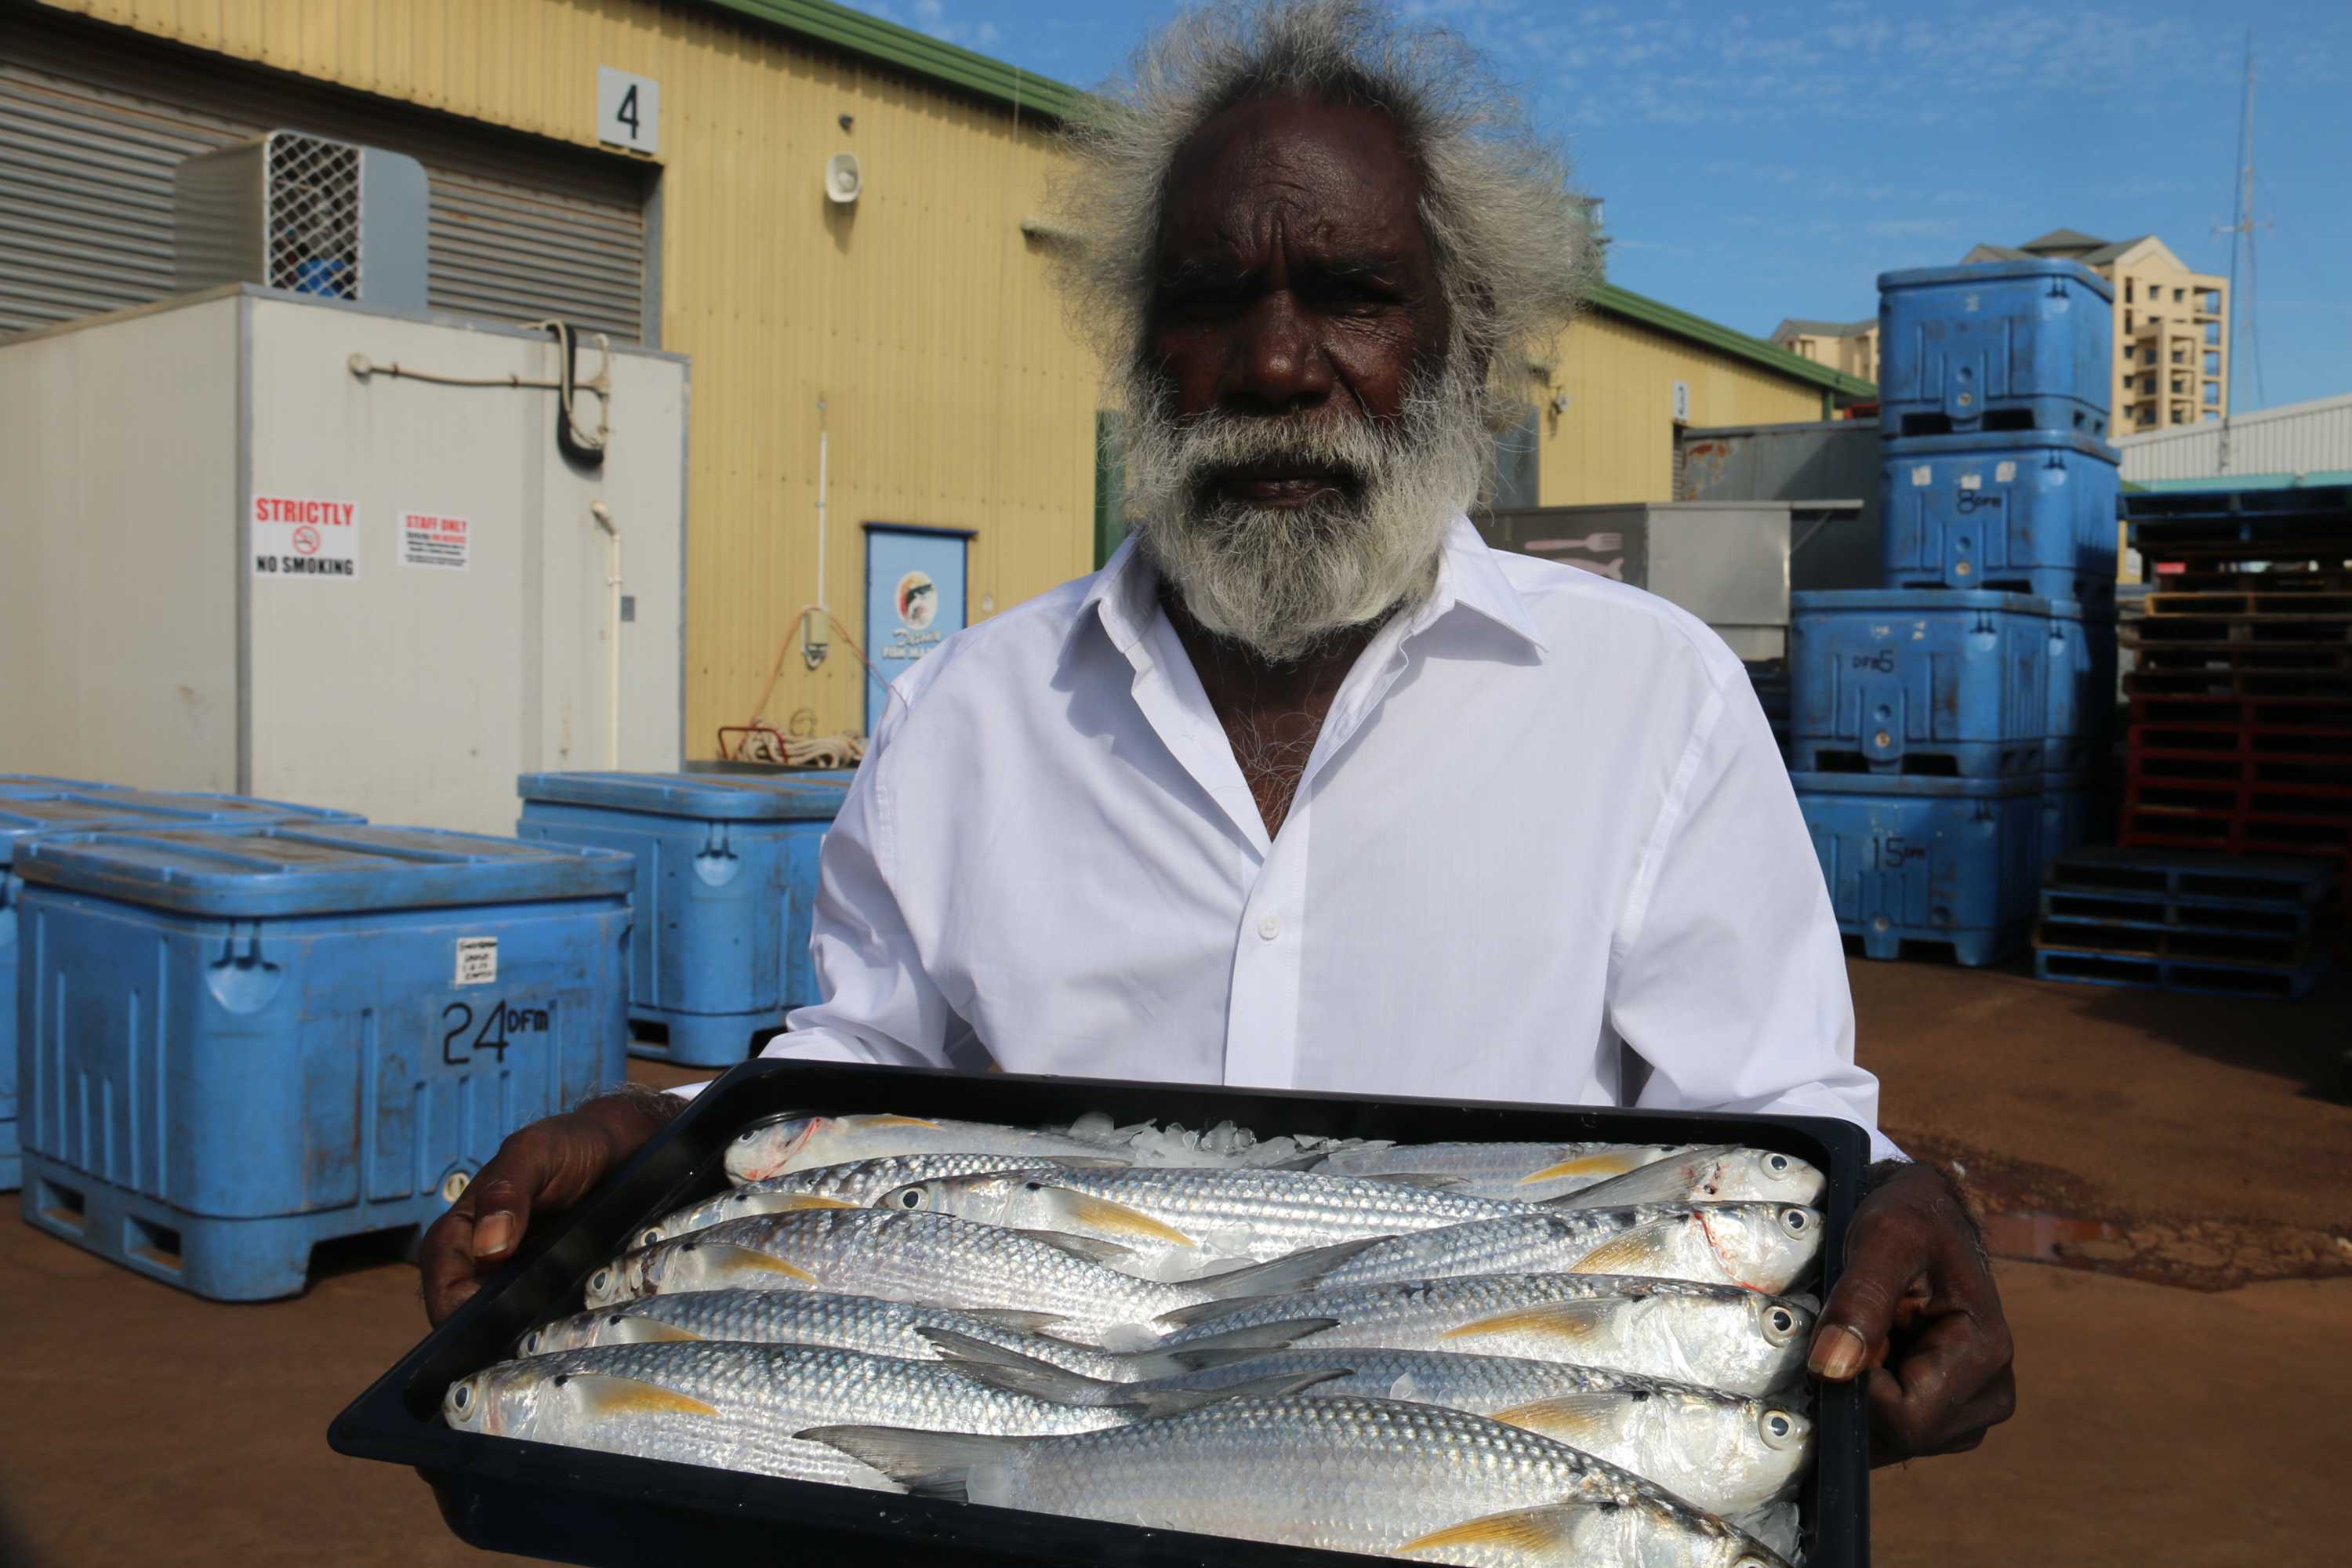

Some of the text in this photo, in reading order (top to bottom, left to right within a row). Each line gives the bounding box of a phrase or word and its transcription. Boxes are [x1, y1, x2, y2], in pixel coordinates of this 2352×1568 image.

[617, 83, 639, 140] 4
[256, 498, 354, 525] STRICTLY
[406, 514, 437, 530] STAFF
[256, 556, 354, 575] NO SMOKING
[1873, 837, 1906, 869] 15
[442, 1000, 509, 1065] 24
